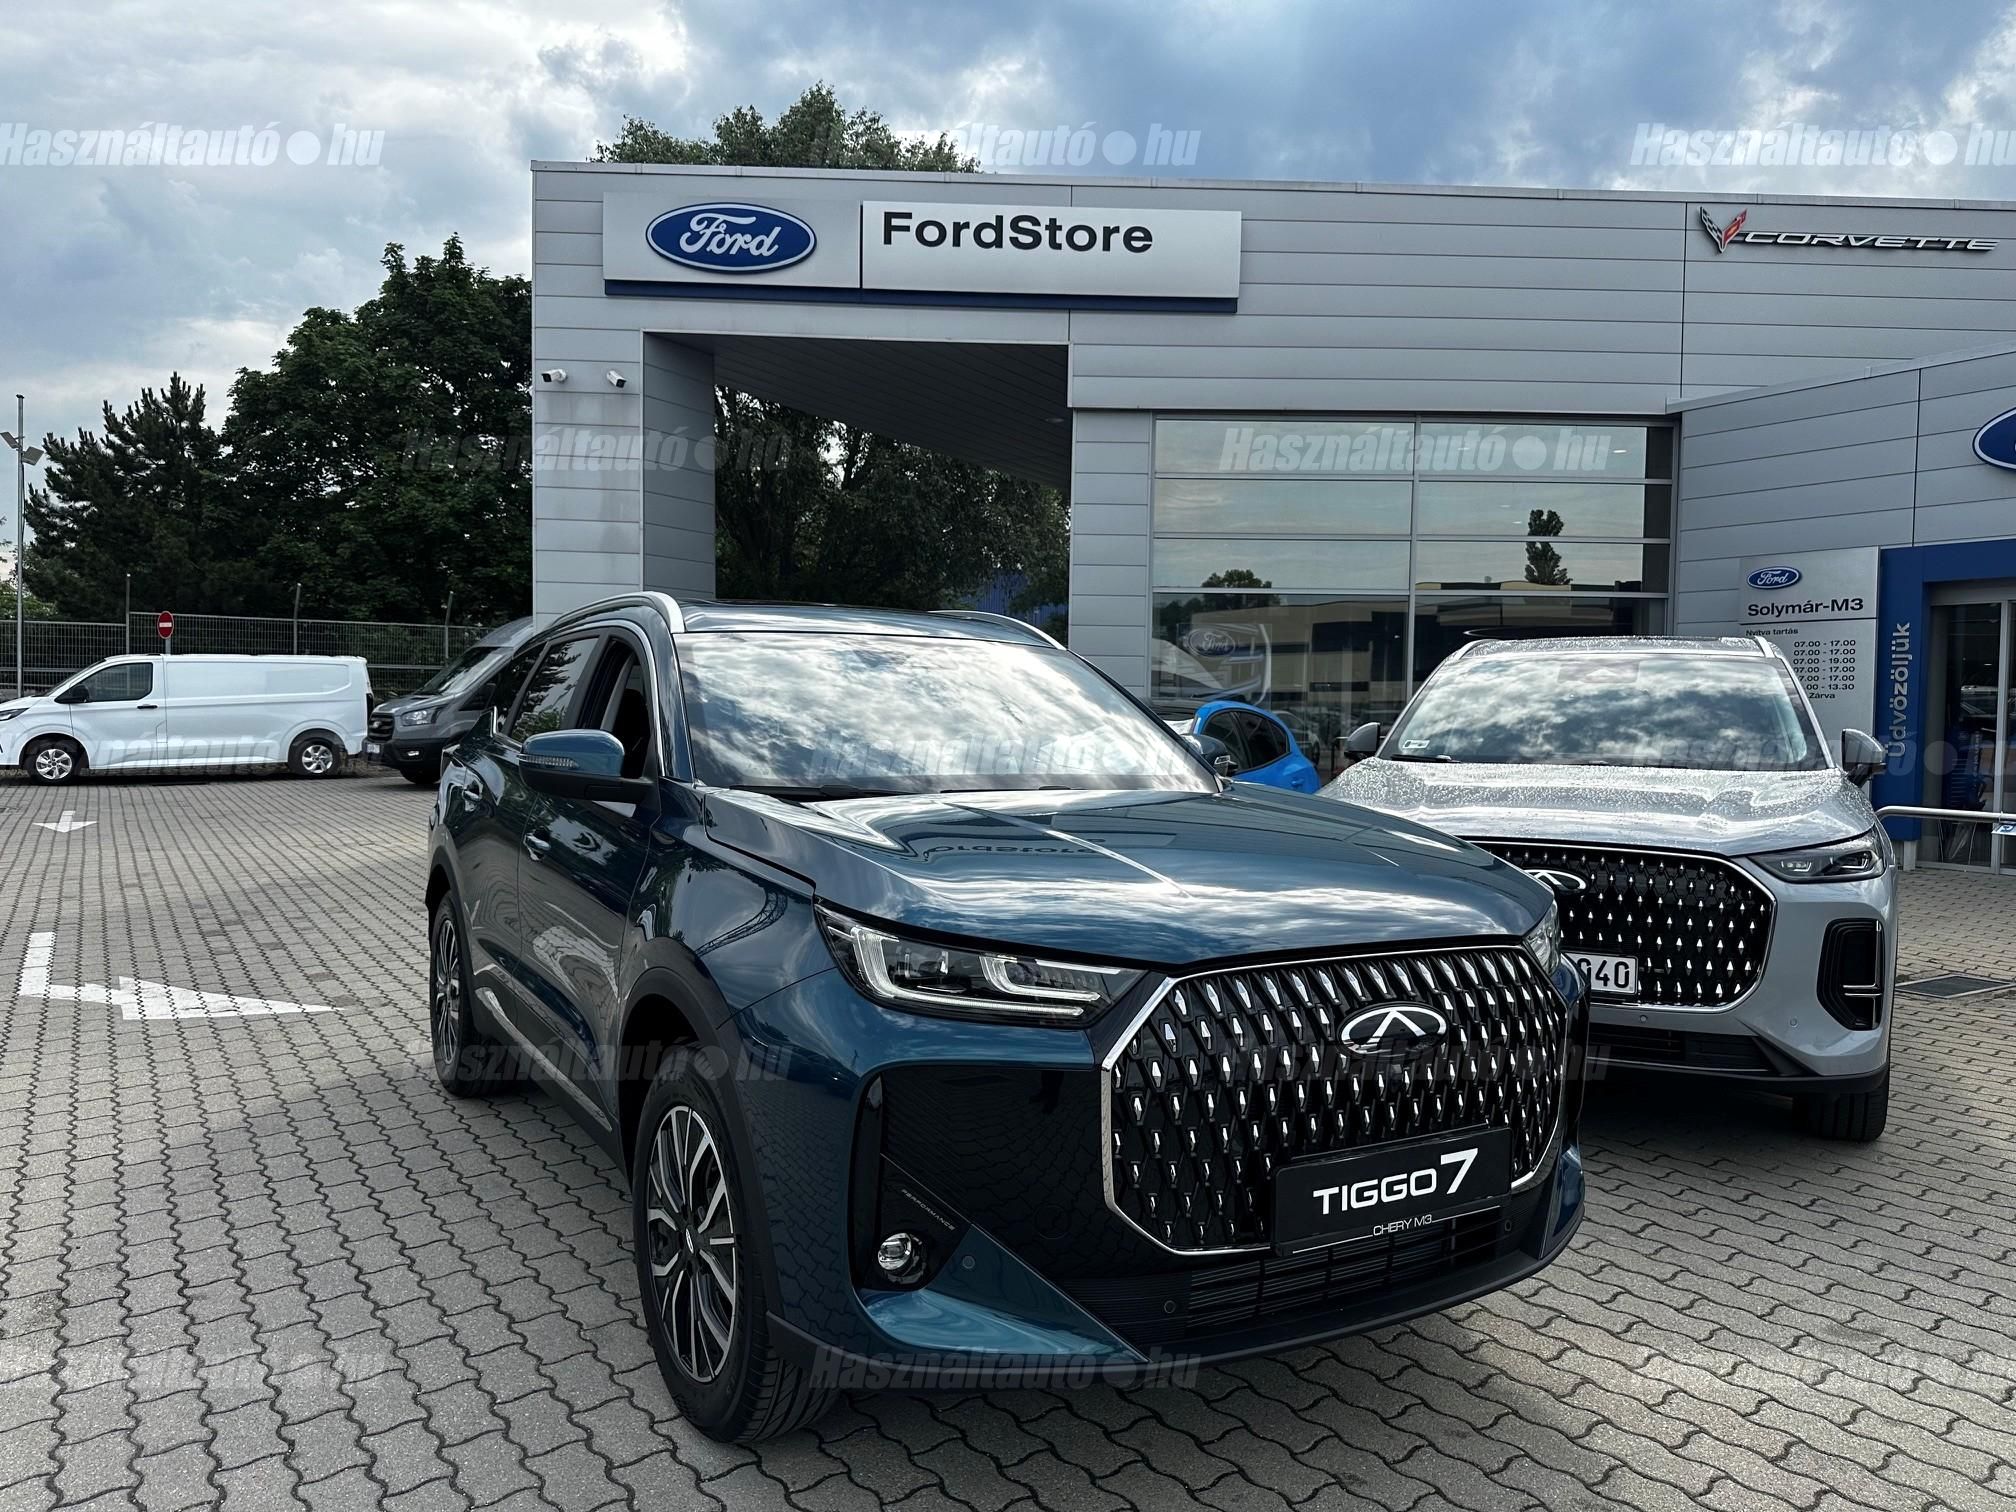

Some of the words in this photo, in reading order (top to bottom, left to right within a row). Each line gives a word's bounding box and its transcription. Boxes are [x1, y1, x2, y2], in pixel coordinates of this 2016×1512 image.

[679, 212, 780, 258] Ford
[882, 211, 1154, 254] FordStore
[1743, 230, 1999, 251] CORVETTE
[1756, 570, 1790, 586] Ford
[1747, 597, 1864, 618] Solymár-M3
[1773, 627, 1799, 636] tartás
[1885, 622, 1912, 758] Üdvözöljük
[1312, 1168, 1437, 1215] TIGGO
[1440, 1147, 1478, 1195] 7
[1373, 1218, 1412, 1236] CHERY
[1413, 1214, 1433, 1227] M3
